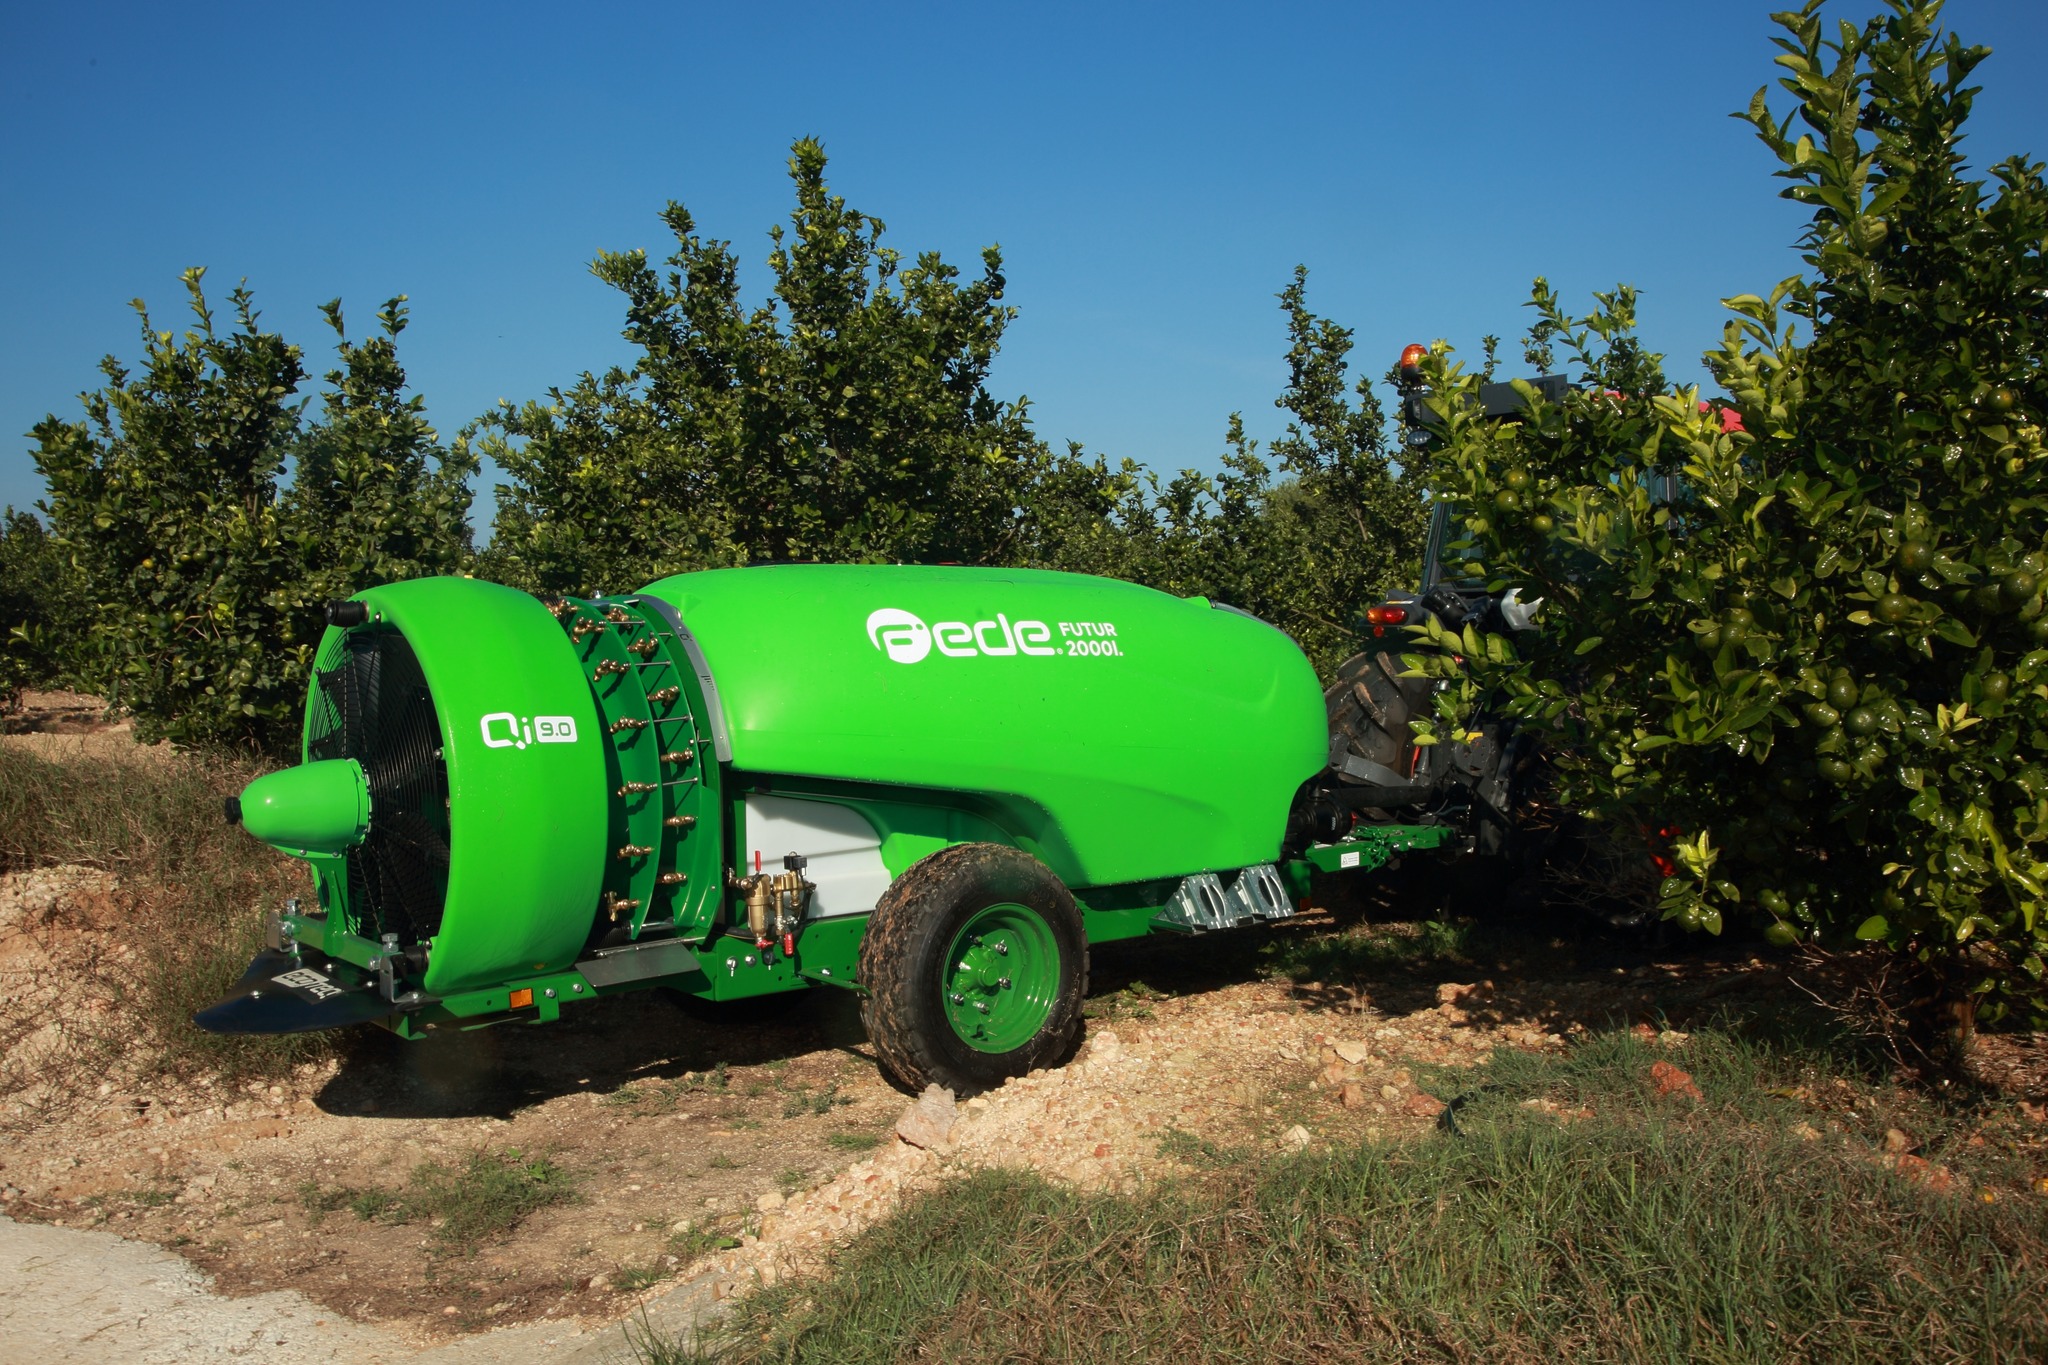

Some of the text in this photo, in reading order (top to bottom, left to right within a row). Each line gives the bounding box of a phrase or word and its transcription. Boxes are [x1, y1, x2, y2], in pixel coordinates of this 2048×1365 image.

[1058, 622, 1118, 637] FUTUR
[480, 712, 571, 750] Qi 9.0
